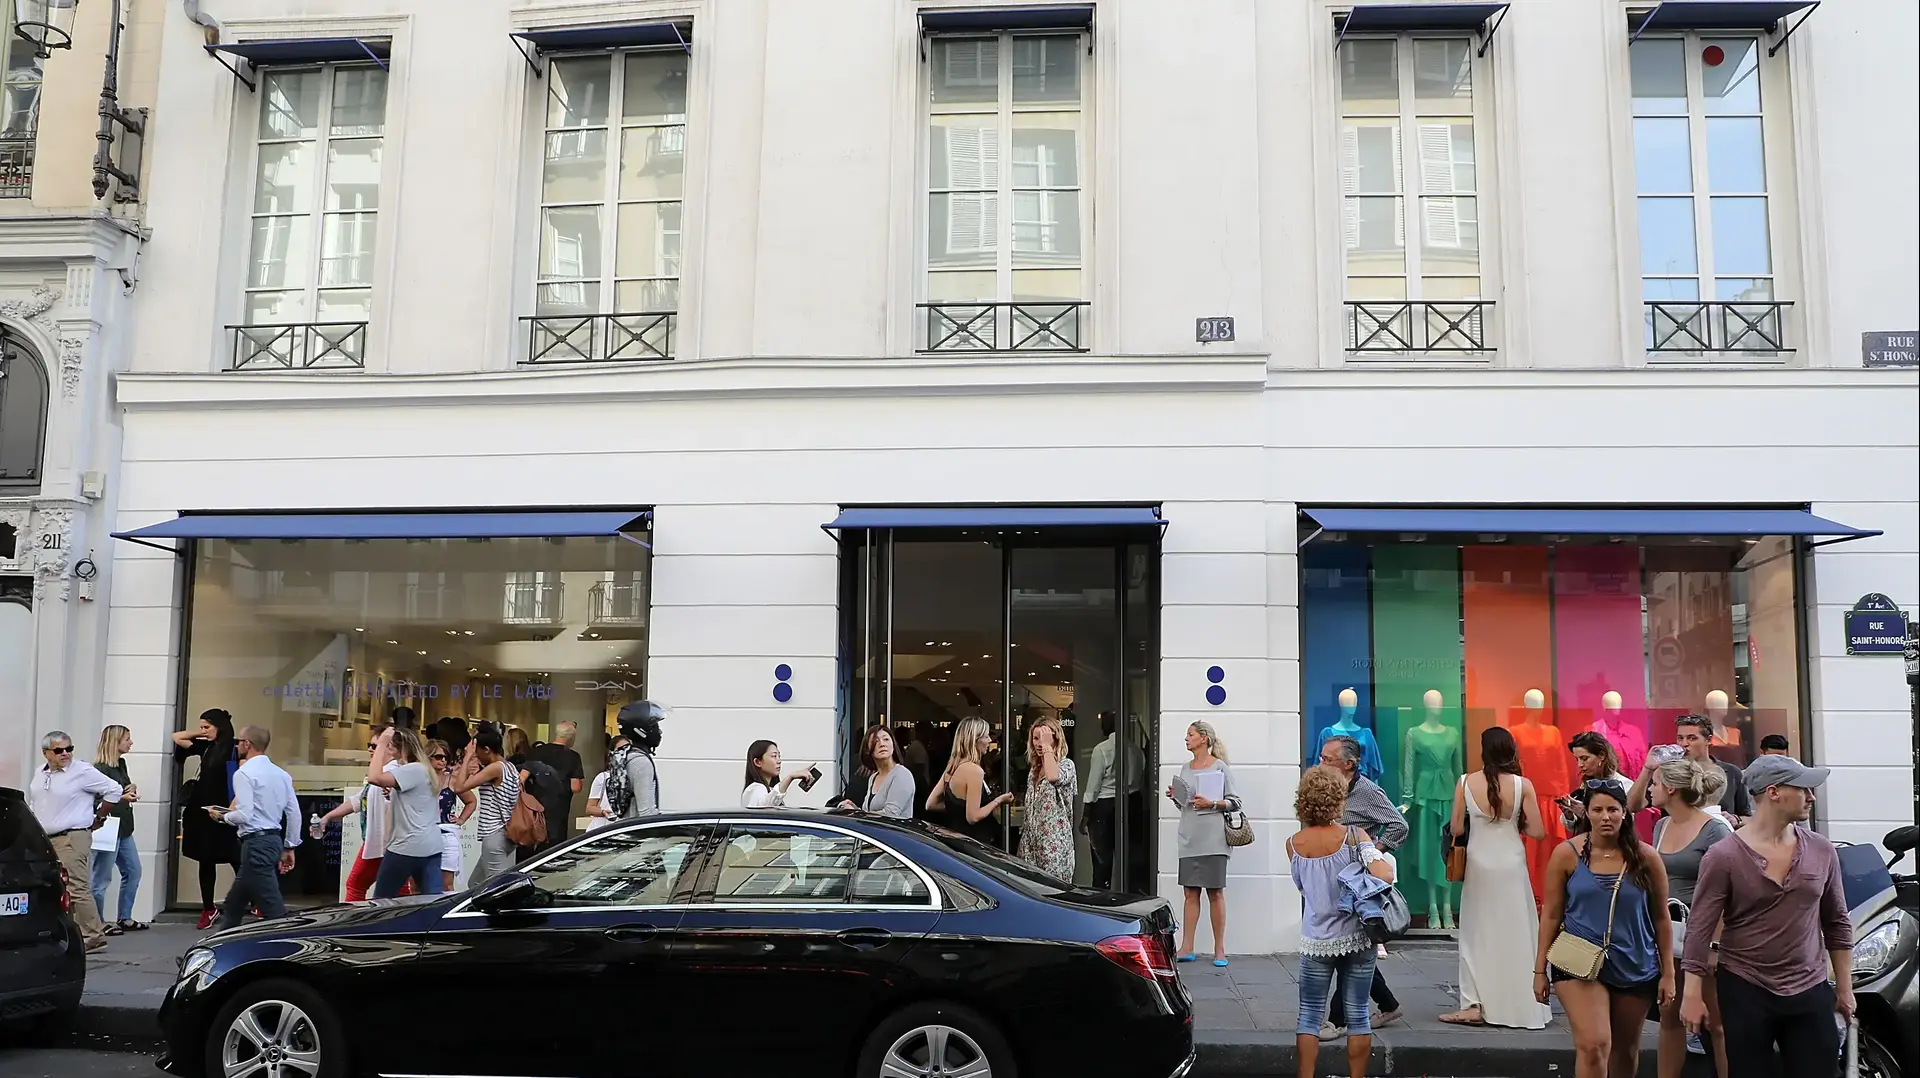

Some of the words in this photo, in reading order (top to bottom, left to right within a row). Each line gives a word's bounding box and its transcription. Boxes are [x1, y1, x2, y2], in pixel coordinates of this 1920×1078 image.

[1200, 321, 1231, 339] 213
[1887, 336, 1915, 348] RUE
[1883, 351, 1919, 361] HONO
[42, 533, 61, 550] 211
[1869, 622, 1884, 630] RUE
[1851, 635, 1905, 645] SAINT-HONORÉ
[450, 684, 470, 699] BY
[482, 684, 502, 699] LE
